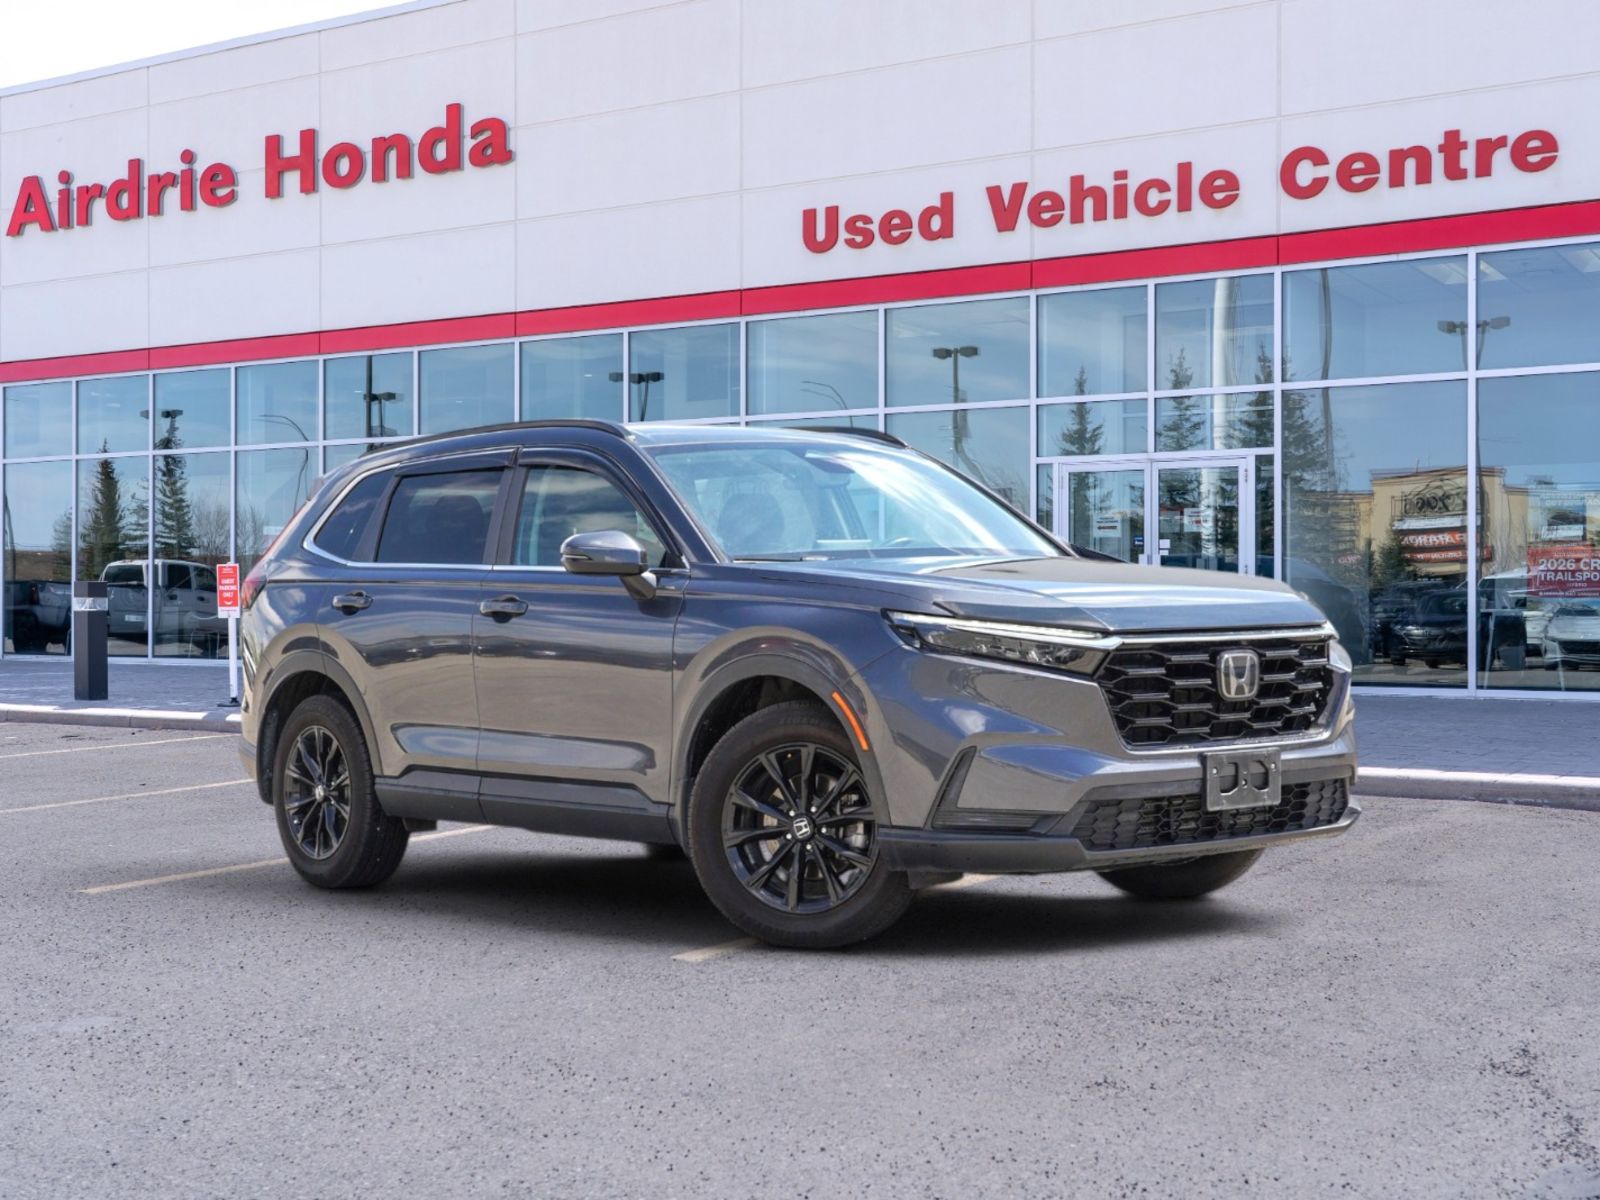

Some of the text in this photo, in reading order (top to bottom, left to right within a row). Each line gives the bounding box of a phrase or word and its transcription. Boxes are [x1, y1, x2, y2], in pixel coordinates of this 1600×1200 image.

[7, 103, 513, 237] Airdrie Honda
[802, 129, 1558, 253] Used Vehicle Centre
[1539, 559, 1575, 570] 2026
[1539, 571, 1600, 581] TRAILSPO
